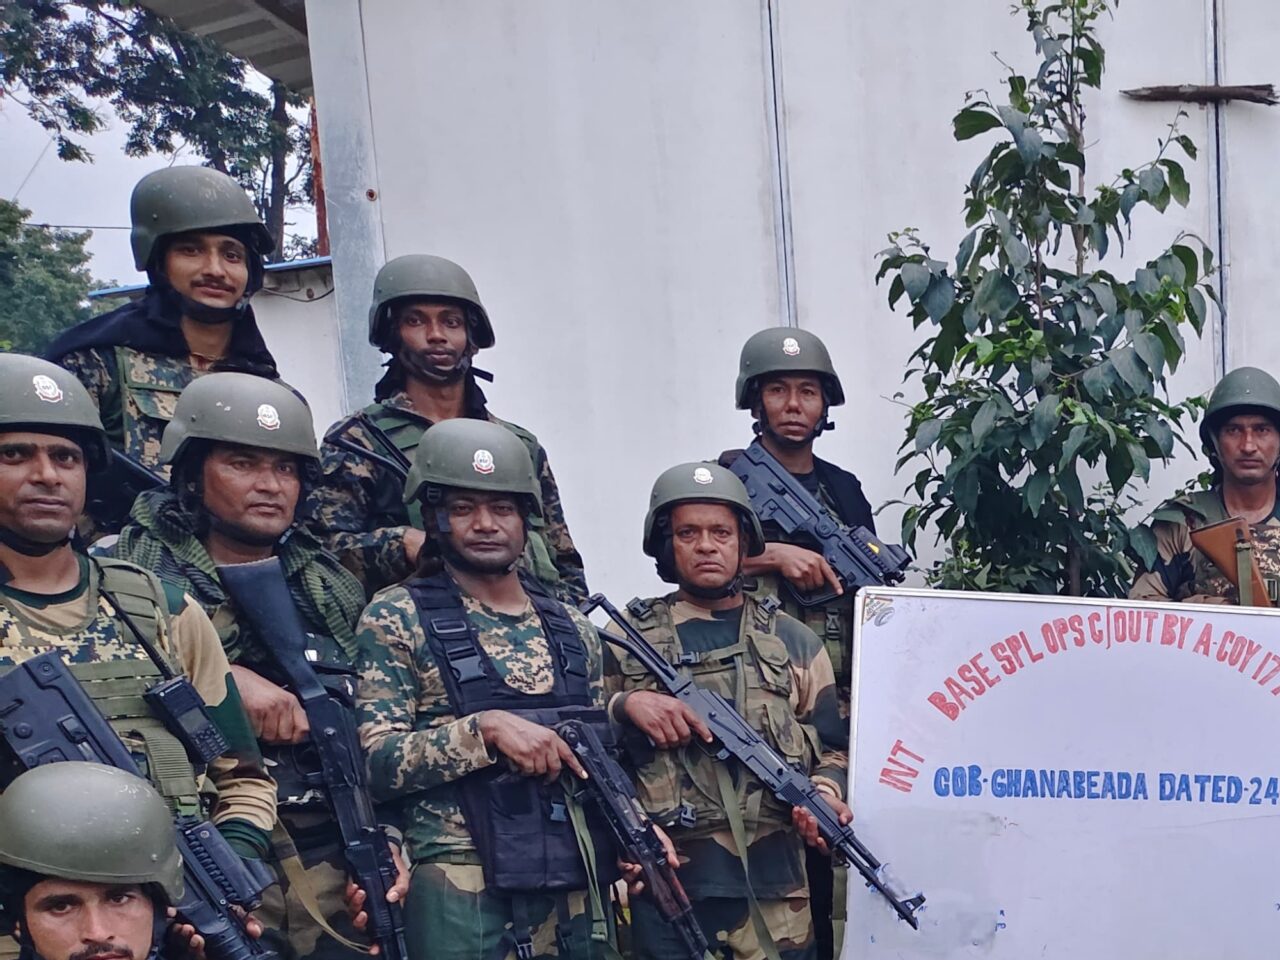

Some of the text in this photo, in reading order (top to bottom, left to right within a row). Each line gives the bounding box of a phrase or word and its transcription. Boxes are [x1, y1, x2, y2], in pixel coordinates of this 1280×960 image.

[879, 739, 925, 793] INT
[928, 652, 1001, 721] BASE
[990, 631, 1044, 675] SPL
[1041, 614, 1085, 654] OPS
[1160, 614, 1194, 650] BY
